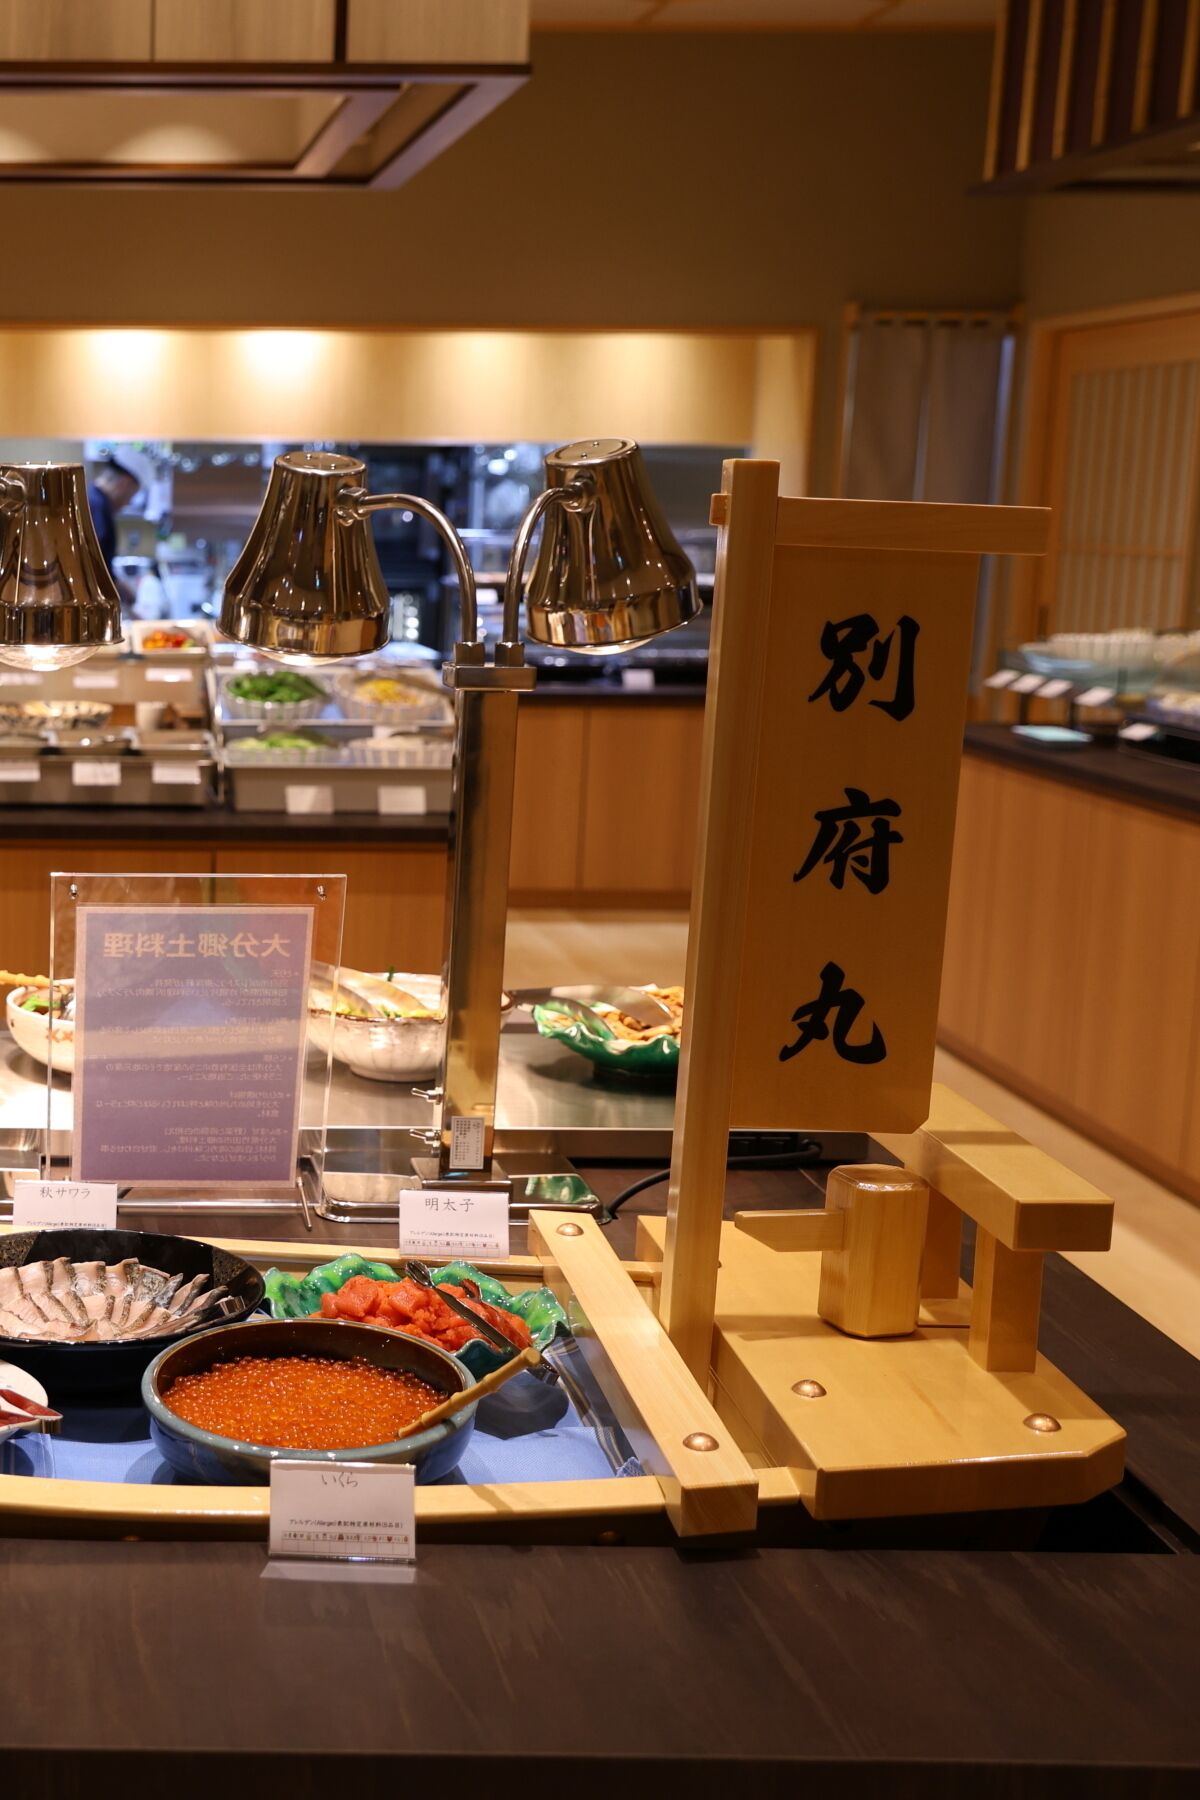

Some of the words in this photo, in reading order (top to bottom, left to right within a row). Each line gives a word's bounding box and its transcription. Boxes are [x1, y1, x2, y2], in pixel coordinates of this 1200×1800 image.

[779, 613, 921, 1065] 別府丸
[39, 1186, 92, 1200] 秋サワラ
[424, 1197, 475, 1213] 明太子
[321, 1471, 359, 1488] いくら
